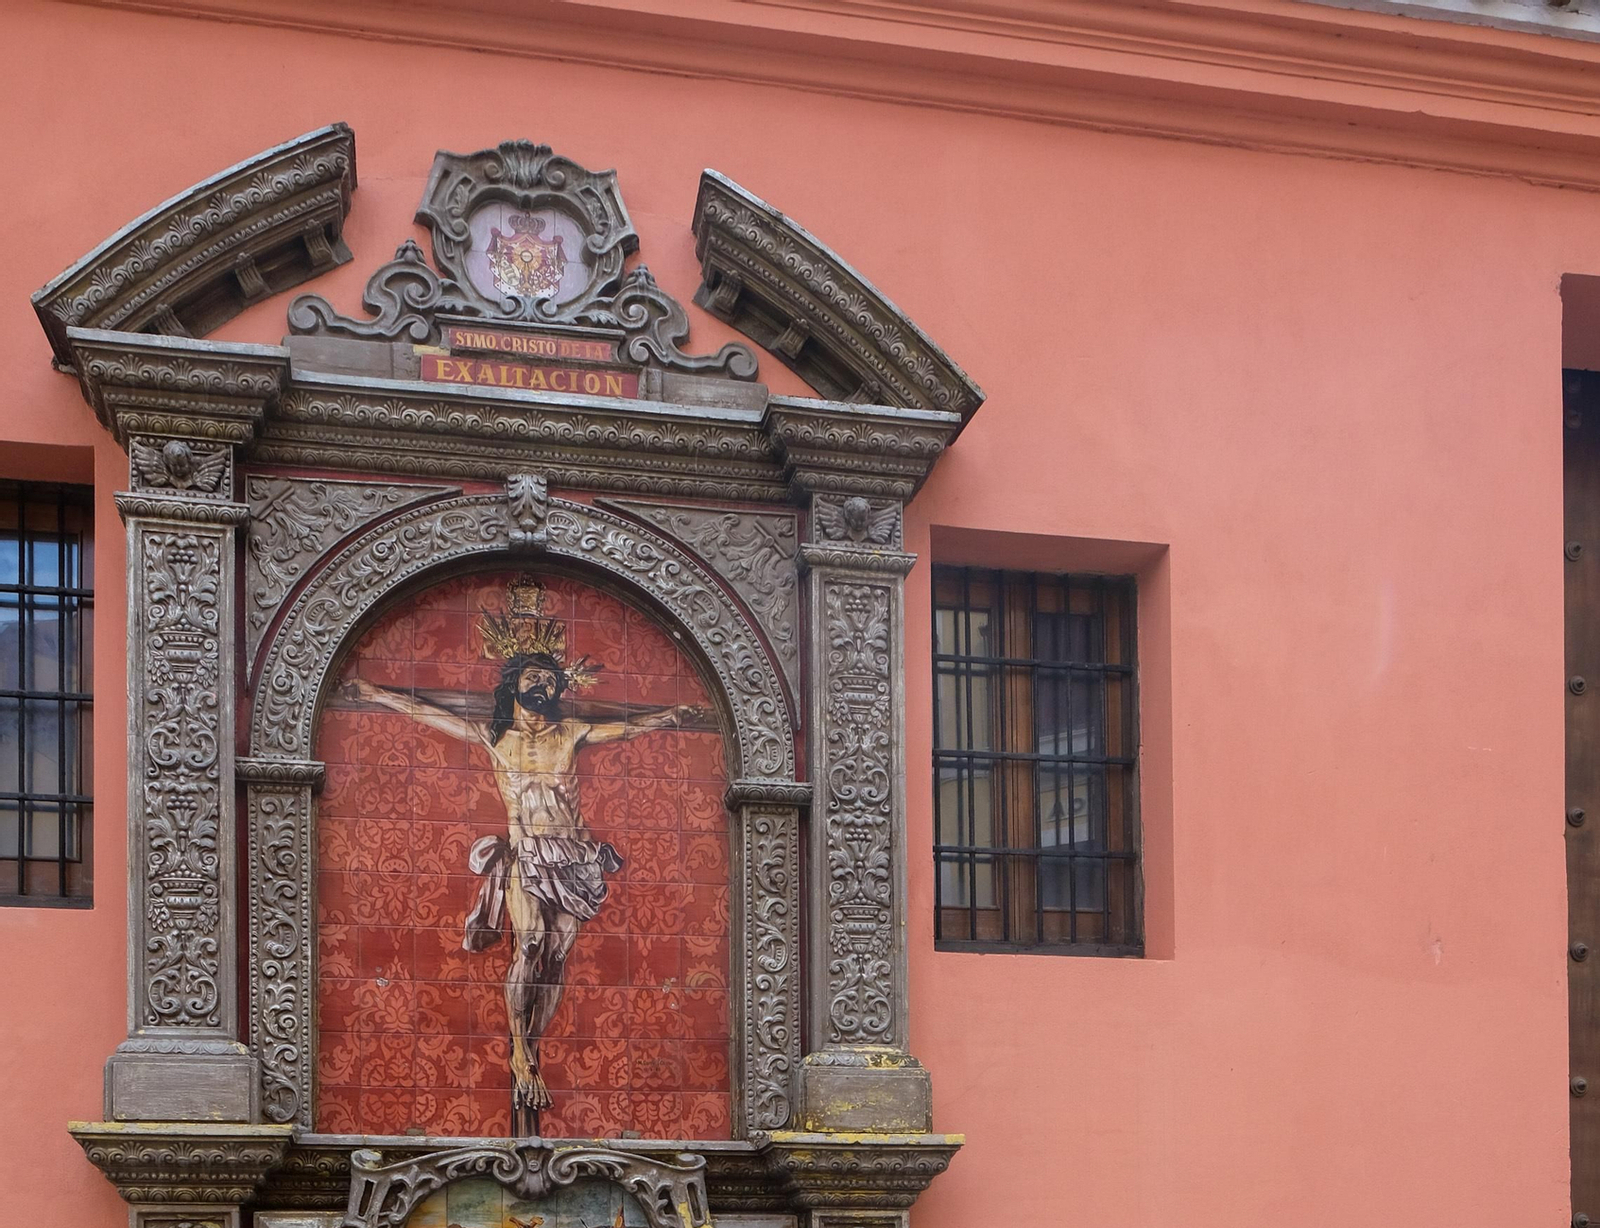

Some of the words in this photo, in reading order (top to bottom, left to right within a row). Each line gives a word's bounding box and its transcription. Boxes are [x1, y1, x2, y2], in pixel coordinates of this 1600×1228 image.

[455, 330, 499, 350] STMO.
[500, 335, 557, 356] CRISTO
[560, 342, 581, 357] DE
[436, 359, 623, 395] EXALTACION
